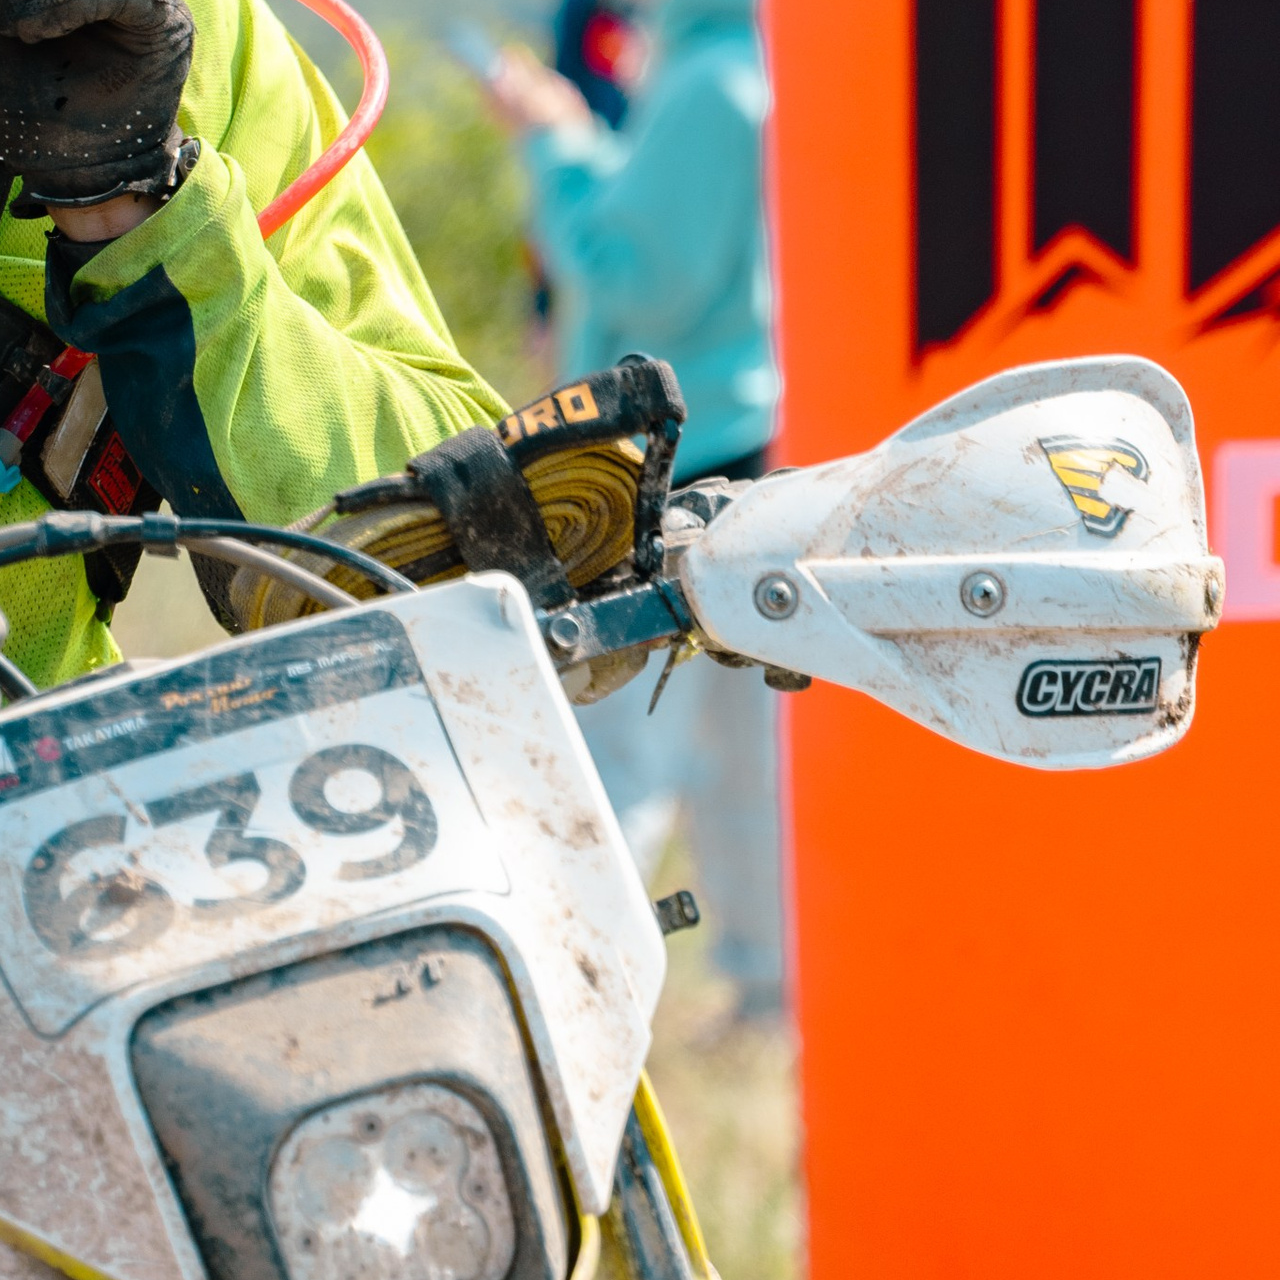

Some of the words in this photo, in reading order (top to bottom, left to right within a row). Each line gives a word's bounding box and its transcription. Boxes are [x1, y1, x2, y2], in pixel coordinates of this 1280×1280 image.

[1023, 664, 1158, 710] CYCRA
[63, 715, 148, 751] TAKAYAMA
[23, 743, 438, 957] 639
